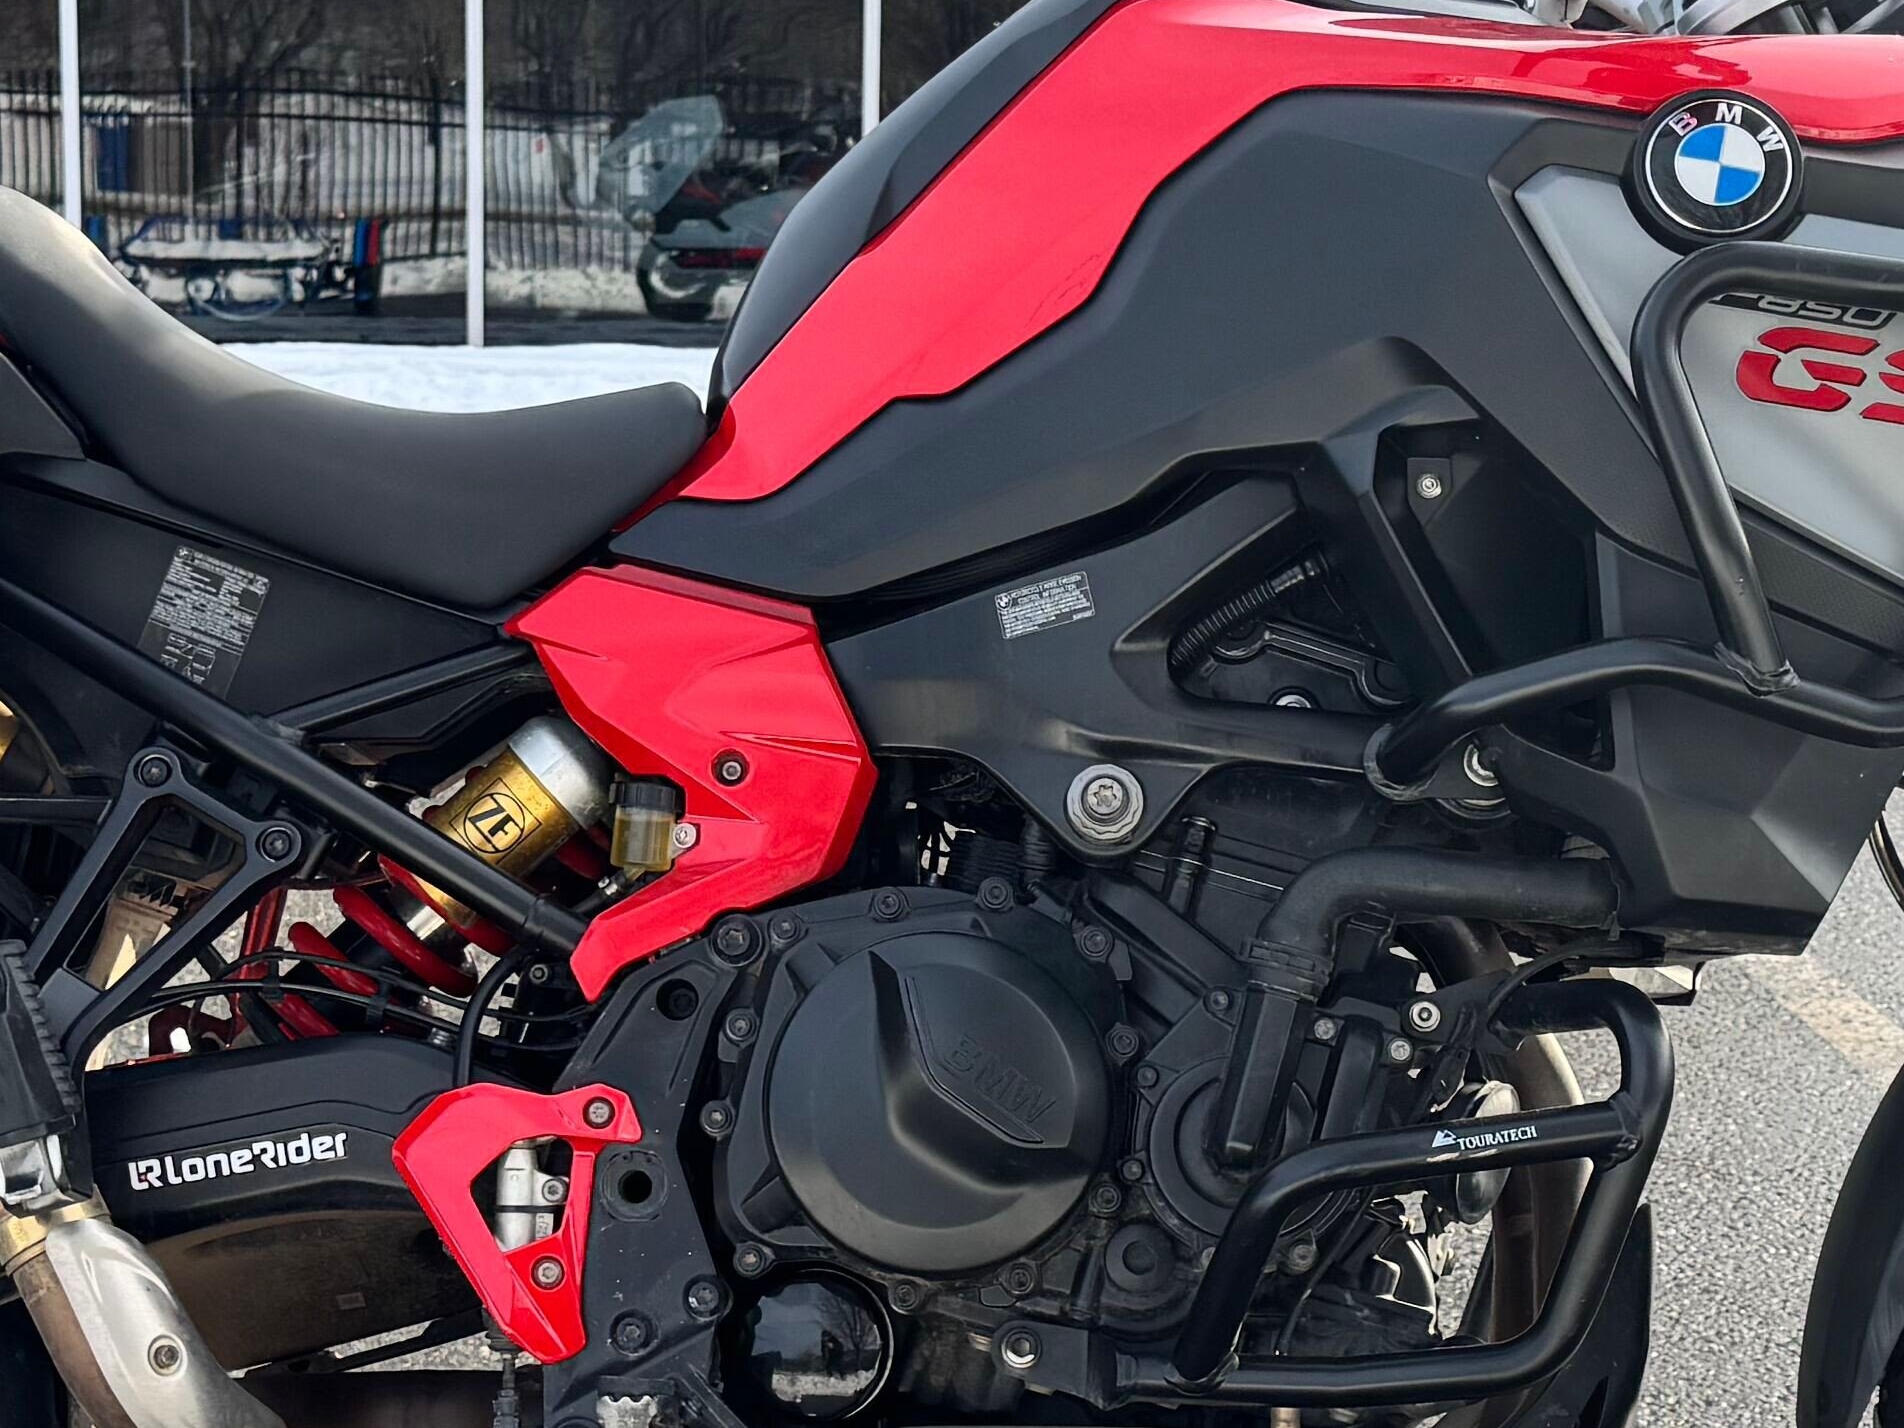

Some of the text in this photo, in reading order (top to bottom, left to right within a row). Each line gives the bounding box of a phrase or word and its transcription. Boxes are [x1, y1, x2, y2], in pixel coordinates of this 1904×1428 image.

[1668, 102, 1785, 153] BMW
[467, 793, 525, 853] ZF
[941, 1033, 1056, 1123] BMW
[1457, 1124, 1538, 1151] TOURATECH
